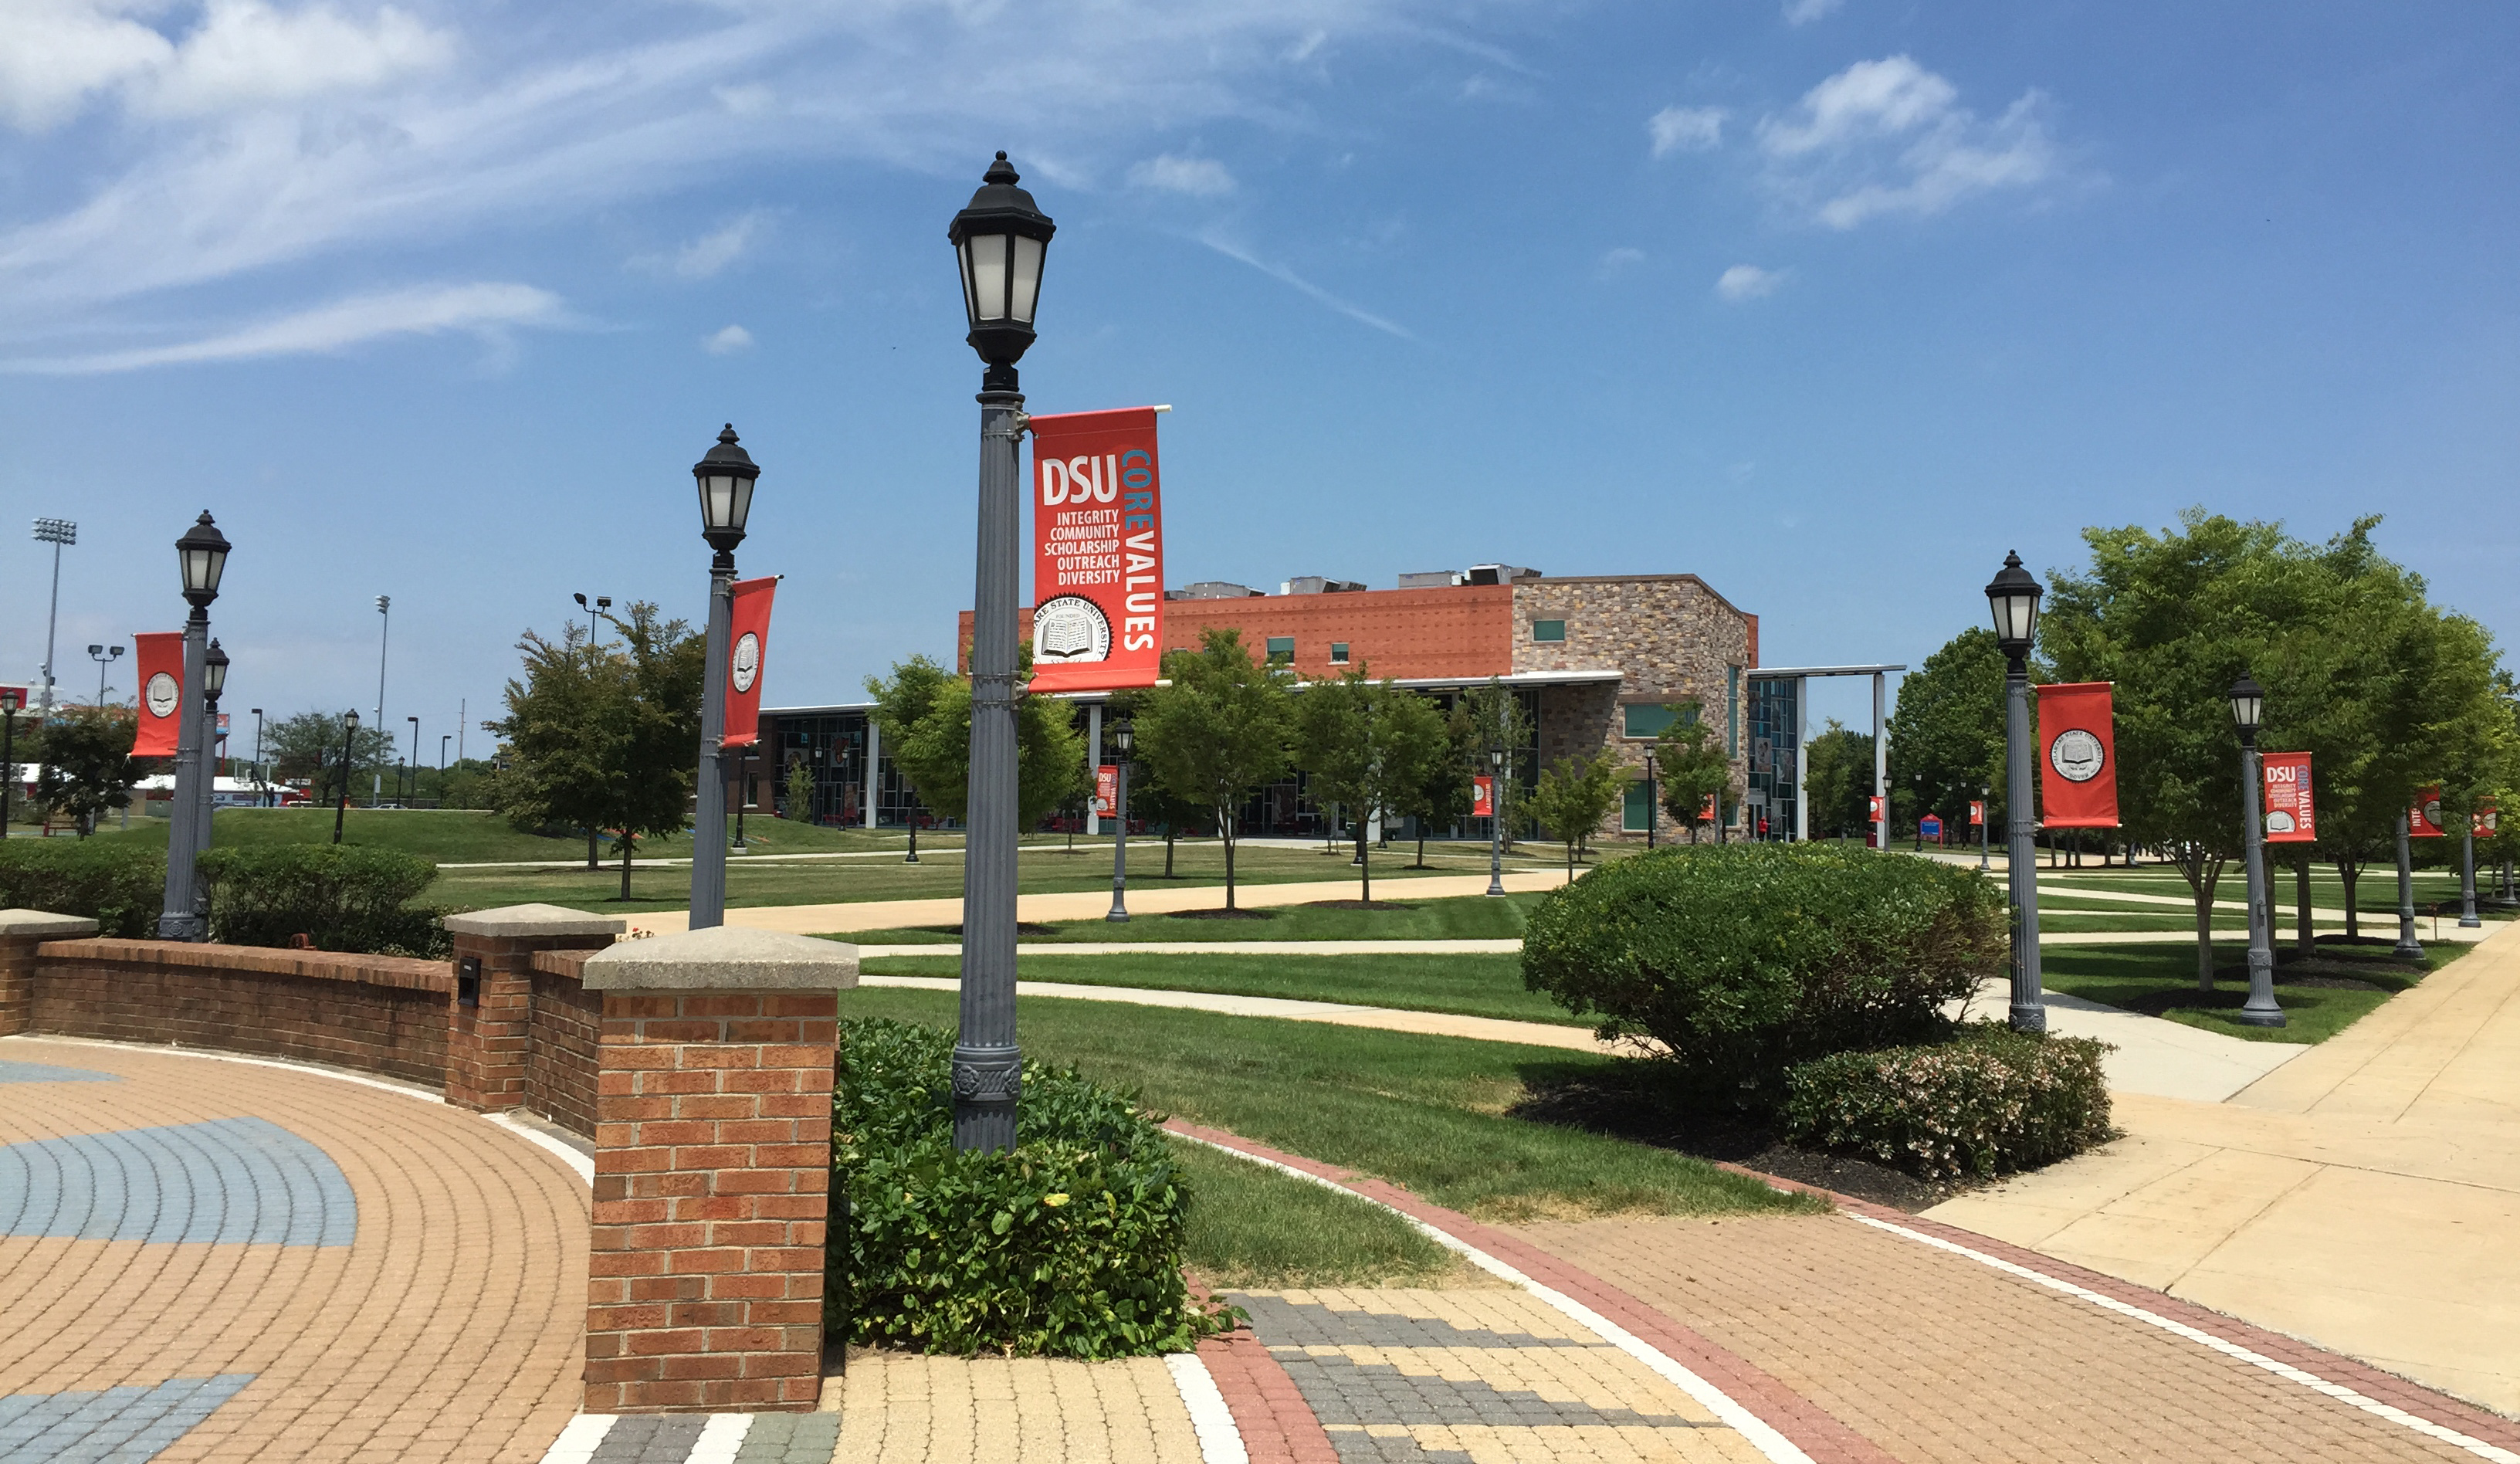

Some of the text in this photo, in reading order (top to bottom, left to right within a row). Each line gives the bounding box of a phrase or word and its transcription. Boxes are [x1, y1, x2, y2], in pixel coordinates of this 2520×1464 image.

[1042, 455, 1117, 506] DSU
[1057, 509, 1119, 526] INTEGRITY
[1050, 524, 1119, 541] COMMUNITY
[1045, 539, 1119, 556] SCHOLARSHIP
[1058, 554, 1119, 571] OUTREACH
[1058, 569, 1120, 585] DIVERSITY
[1051, 598, 1081, 609] STATE
[1082, 604, 1108, 658] UNIVERSITY
[1099, 773, 1111, 782] DSU
[2267, 766, 2295, 782] DSU
